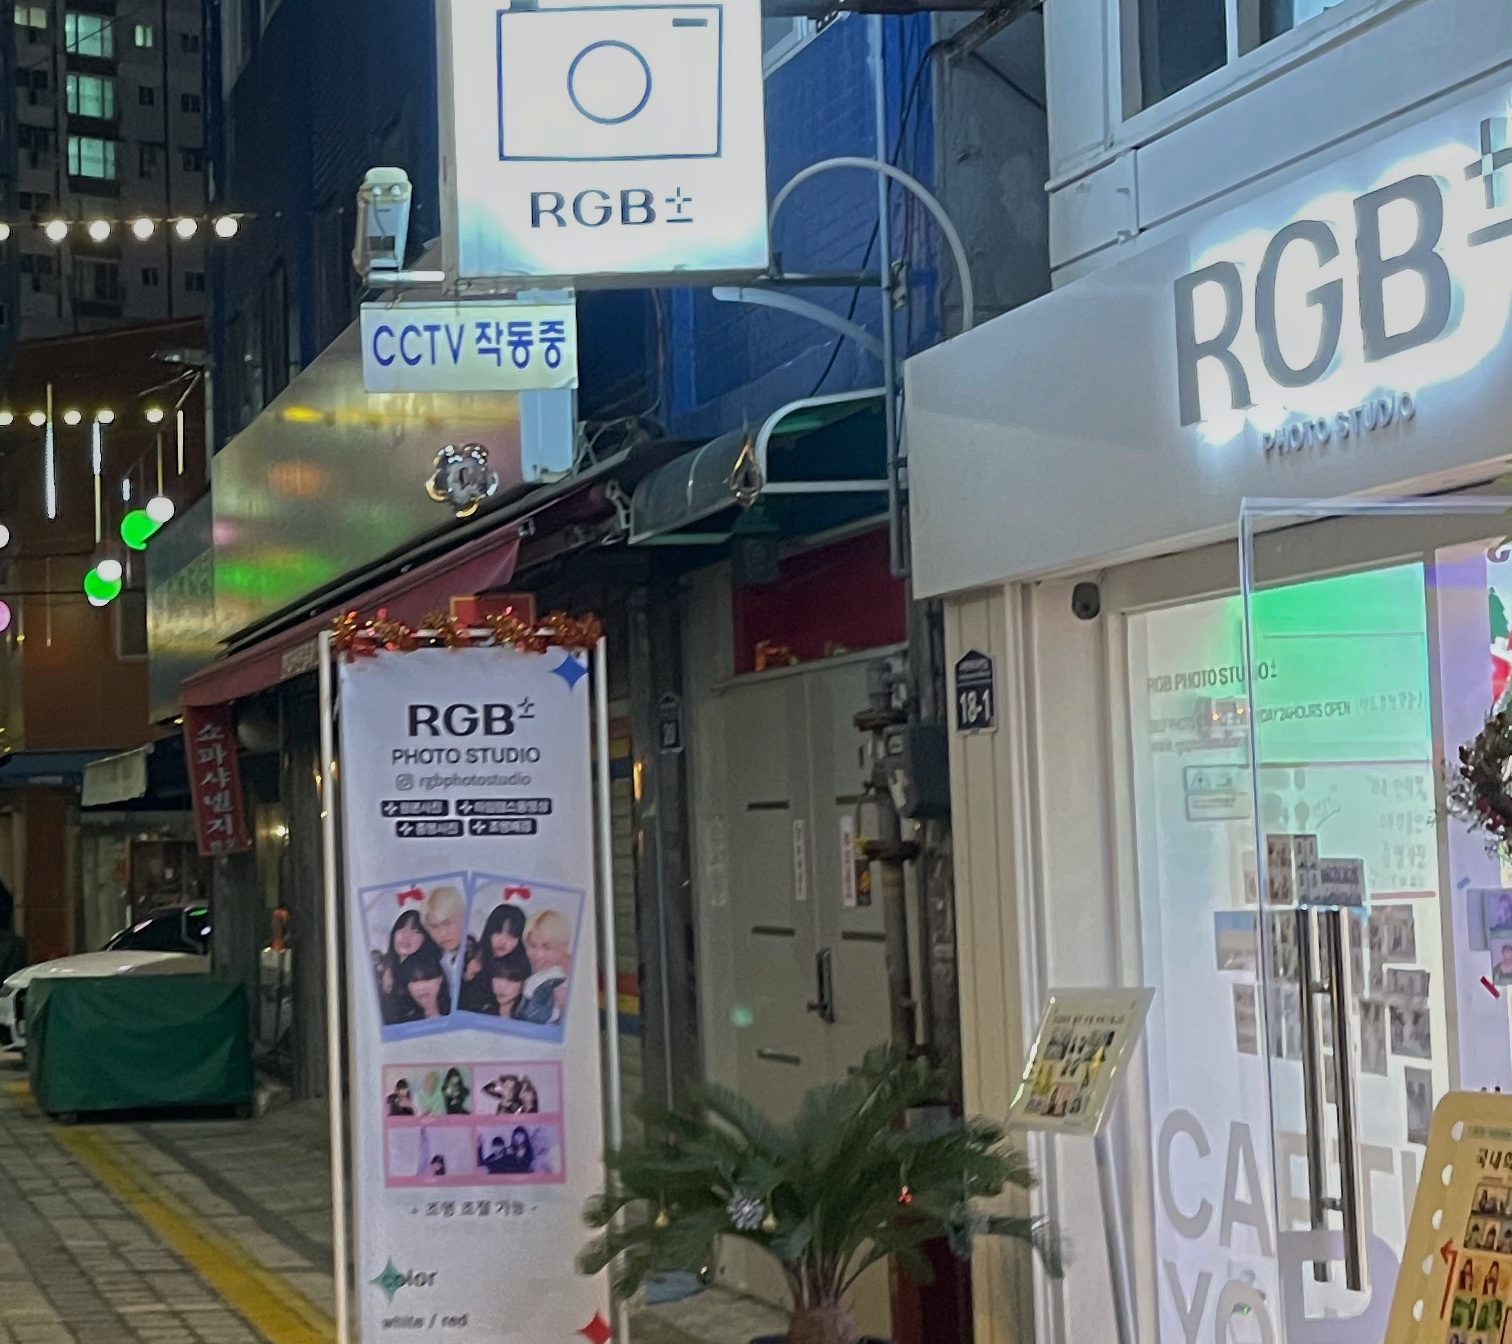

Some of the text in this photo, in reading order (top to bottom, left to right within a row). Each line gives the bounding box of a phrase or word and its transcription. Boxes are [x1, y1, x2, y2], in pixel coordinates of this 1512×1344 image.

[373, 320, 568, 369] CCTV 작동중
[1262, 391, 1417, 456] PHOTO STUDIO
[1174, 667, 1218, 690] PHOTO
[959, 689, 991, 723] 18-1
[1325, 700, 1351, 717] OPEN
[392, 747, 541, 765] PHOTO STUDIO
